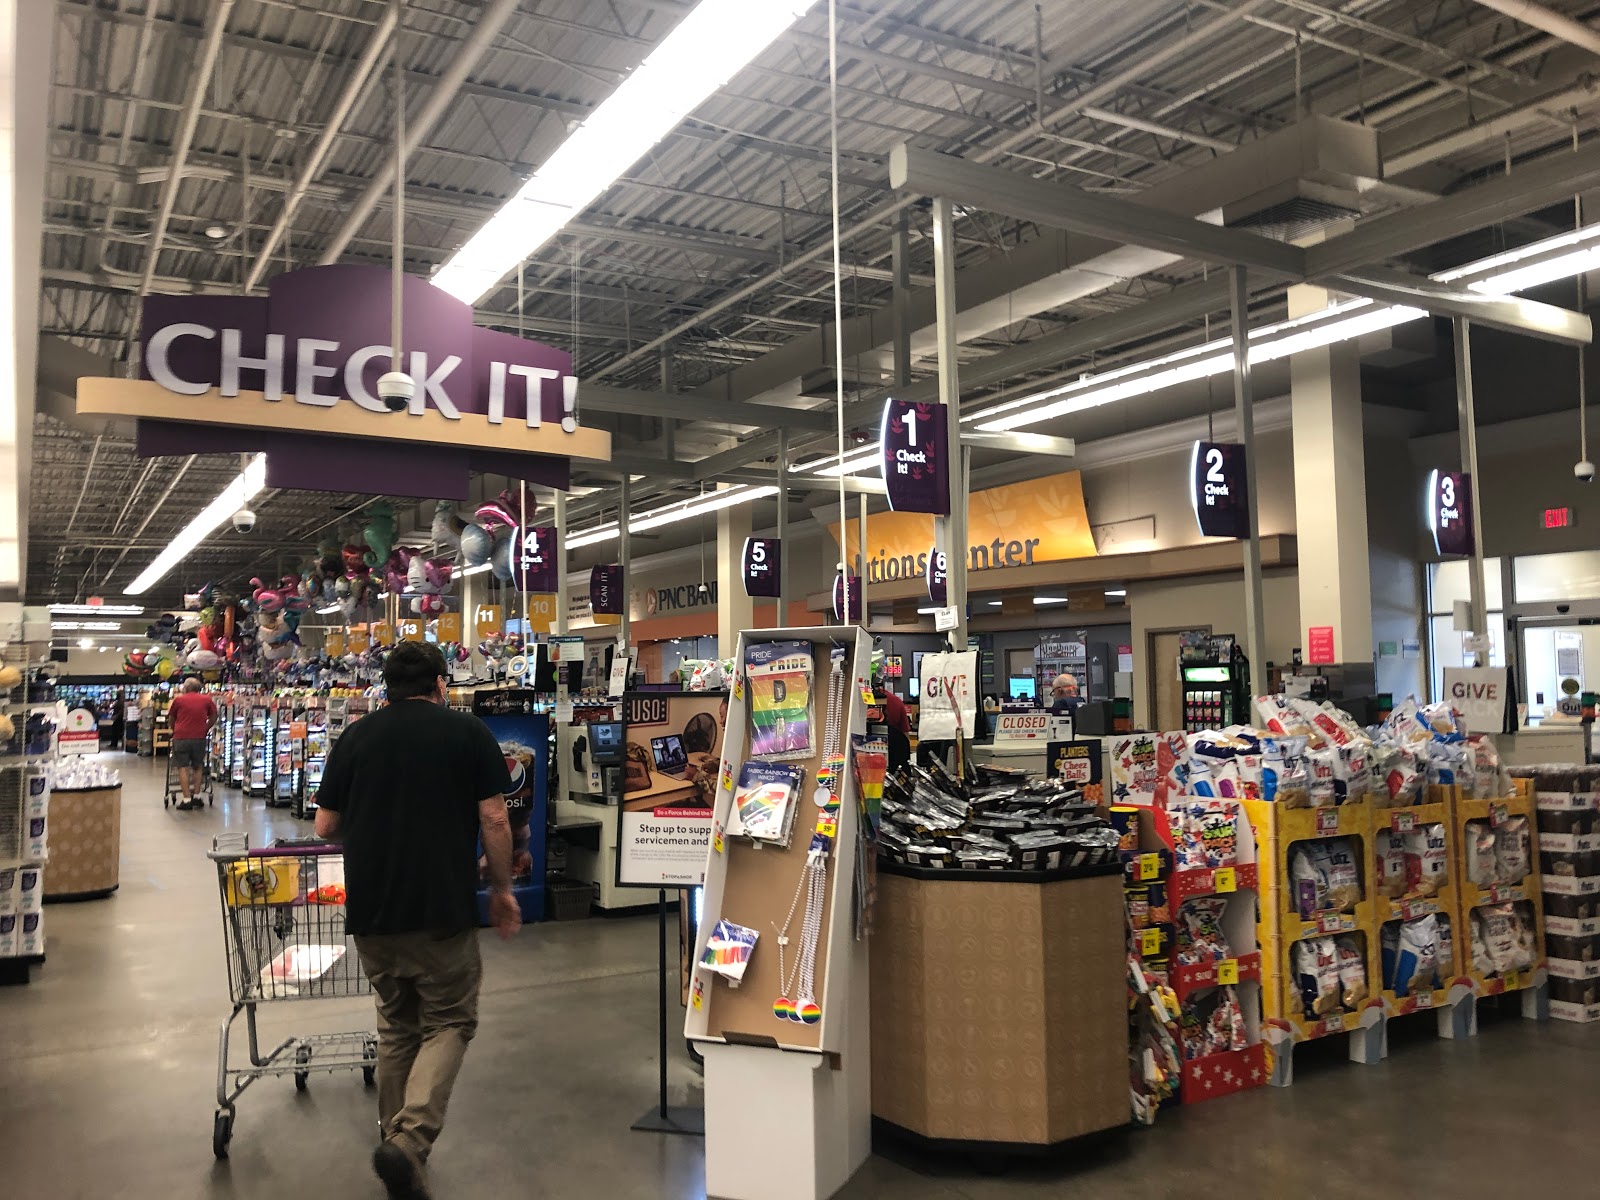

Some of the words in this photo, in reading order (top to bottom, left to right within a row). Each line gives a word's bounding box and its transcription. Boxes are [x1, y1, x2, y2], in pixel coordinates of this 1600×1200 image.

[146, 322, 463, 421] CHECK
[487, 361, 579, 434] IT!
[901, 408, 917, 447] 1
[896, 449, 926, 464] Check
[897, 462, 908, 475] It!
[1205, 448, 1225, 483] 2
[1204, 482, 1229, 496] Check
[1441, 476, 1456, 508] 3
[1440, 507, 1459, 520] Check
[1545, 507, 1567, 529] EXIT
[522, 531, 540, 554] 4
[751, 541, 766, 562] 5
[520, 555, 543, 564] Check
[847, 548, 927, 585] ltions
[967, 536, 1040, 572] nter
[936, 552, 947, 571] 6
[750, 563, 768, 571] Check
[600, 571, 609, 584] IT!
[934, 570, 947, 579] Chec
[600, 584, 609, 608] SCAN
[658, 586, 686, 611] PNC
[686, 580, 718, 608] BAN
[532, 600, 549, 615] 10
[479, 609, 494, 623] 11
[402, 623, 418, 635] 13
[440, 616, 455, 630] 12
[751, 650, 772, 660] PRIDE
[769, 658, 807, 671] PRIDE
[612, 667, 625, 678] GIVE
[926, 674, 967, 698] GIVE
[1452, 681, 1498, 700] GIVE
[631, 699, 661, 722] USO
[1002, 716, 1047, 729] CLOSED
[1060, 745, 1089, 758] PLANTERS
[746, 767, 765, 775] FABRIC
[766, 768, 789, 777] RAINBOW
[1063, 760, 1088, 771] Cheez
[757, 774, 775, 782] WINGS
[1066, 769, 1087, 780] Balls
[504, 796, 525, 808] psi
[682, 809, 701, 817] Behind
[639, 823, 661, 835] Step
[662, 826, 675, 836] up
[676, 825, 687, 834] to
[688, 827, 712, 836] supp
[634, 836, 690, 846] servicemen
[690, 837, 709, 846] and
